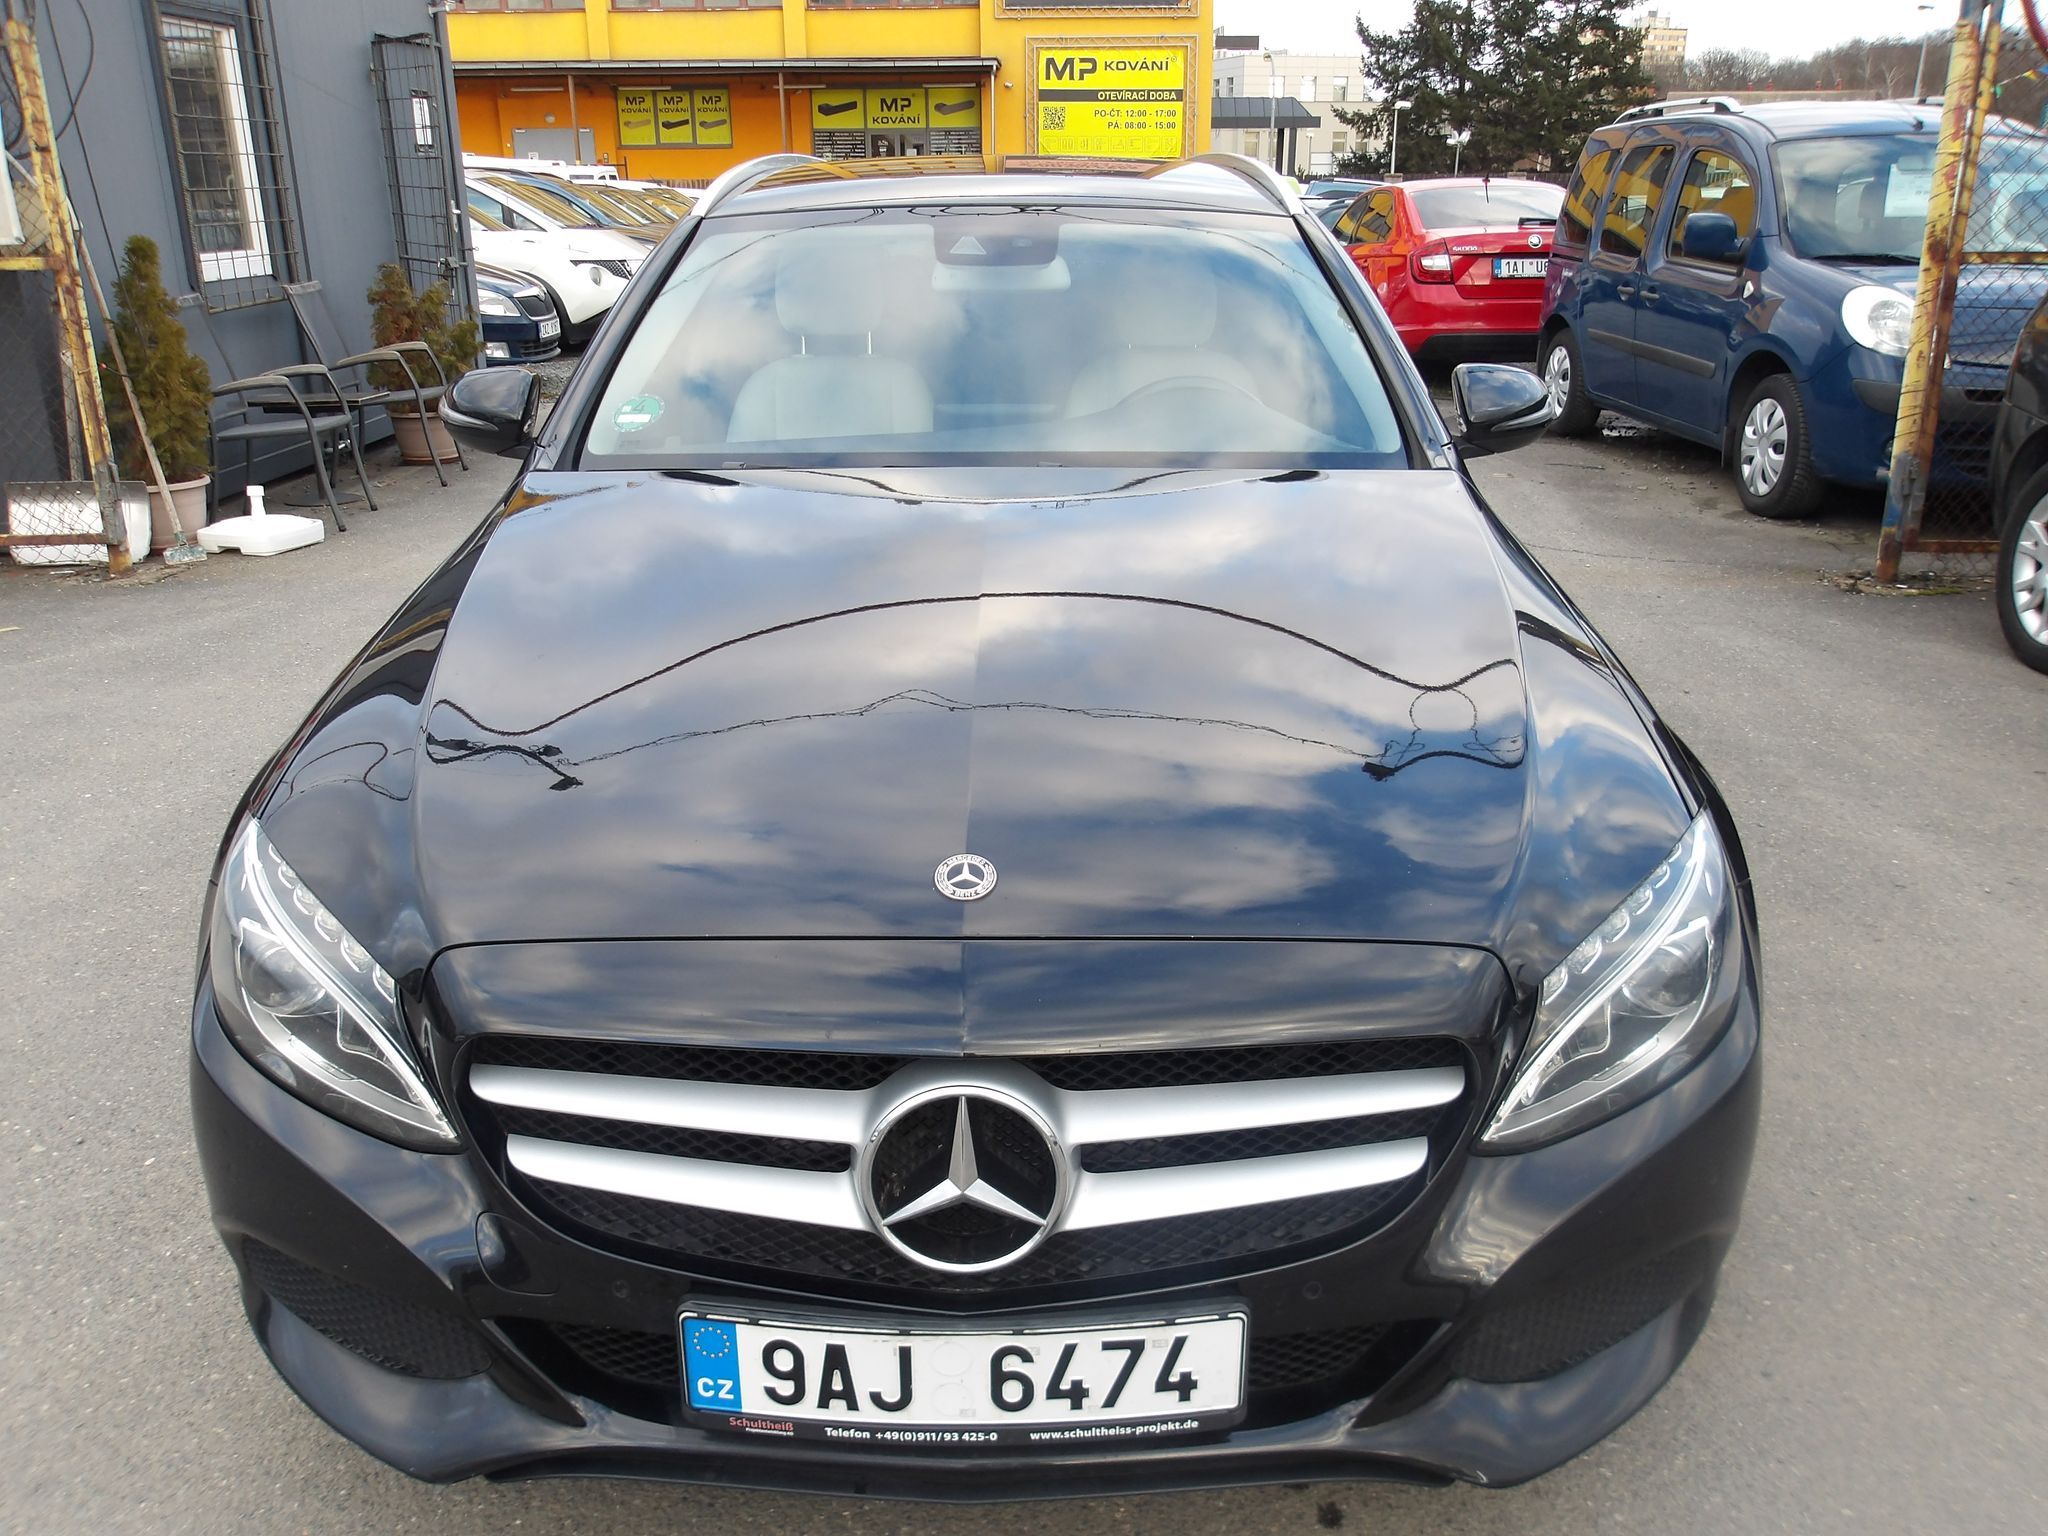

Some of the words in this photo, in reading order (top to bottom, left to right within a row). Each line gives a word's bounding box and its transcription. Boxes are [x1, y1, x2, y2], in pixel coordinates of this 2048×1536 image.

[1045, 57, 1097, 81] MP
[1104, 57, 1169, 72] KOVÁNÍ
[625, 96, 646, 106] MP
[663, 96, 683, 106] MP
[701, 95, 722, 105] MP
[1097, 89, 1148, 101] OTEVÍRACÍ
[1149, 90, 1177, 101] DOBA
[879, 97, 912, 113] MP
[872, 113, 921, 125] KOVÁNÍ
[1125, 109, 1147, 118] 12:00
[1155, 109, 1177, 118] 17:00
[1124, 121, 1147, 130] 08:00
[1155, 121, 1177, 130] 15:00
[762, 1338, 914, 1412] 9AJ
[990, 1335, 1198, 1412] 6474
[697, 1377, 735, 1400] CZ
[729, 1416, 794, 1431] Schultheiß
[1029, 1419, 1199, 1440] www.schultheiss-projekt.de
[824, 1427, 871, 1439] Telefon
[962, 1432, 998, 1442] 425-0
